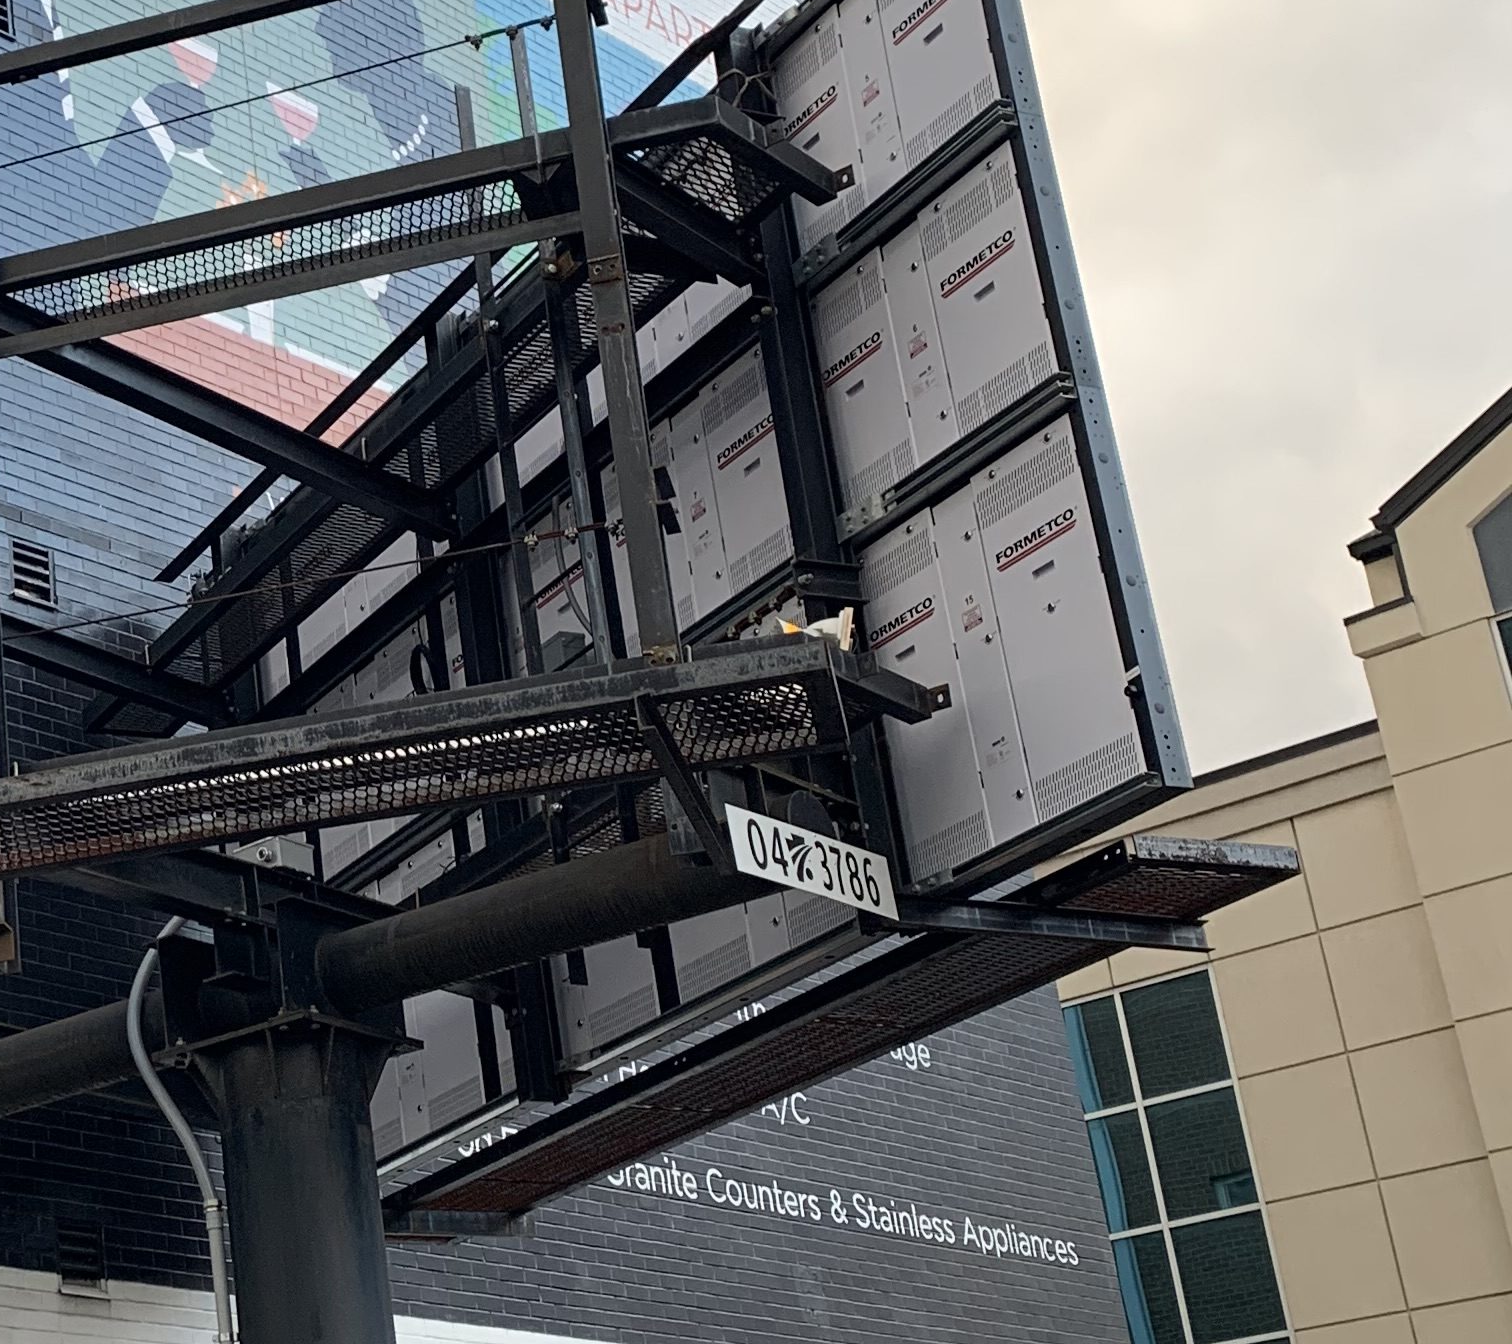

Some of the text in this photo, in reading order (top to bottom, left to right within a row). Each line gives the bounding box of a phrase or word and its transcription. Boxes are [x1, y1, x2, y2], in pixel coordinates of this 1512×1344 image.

[784, 85, 836, 136] RMETCO
[940, 230, 1013, 292] FORMETCO
[823, 331, 881, 381] ORMETCO
[716, 413, 775, 464] FORMETCO
[995, 508, 1074, 564] FORMETCO
[870, 597, 933, 642] ORMETCO
[706, 1167, 822, 1222] Counters
[830, 1189, 849, 1225] &
[852, 1192, 956, 1246] Stainless
[962, 1215, 1080, 1266] Appliances
